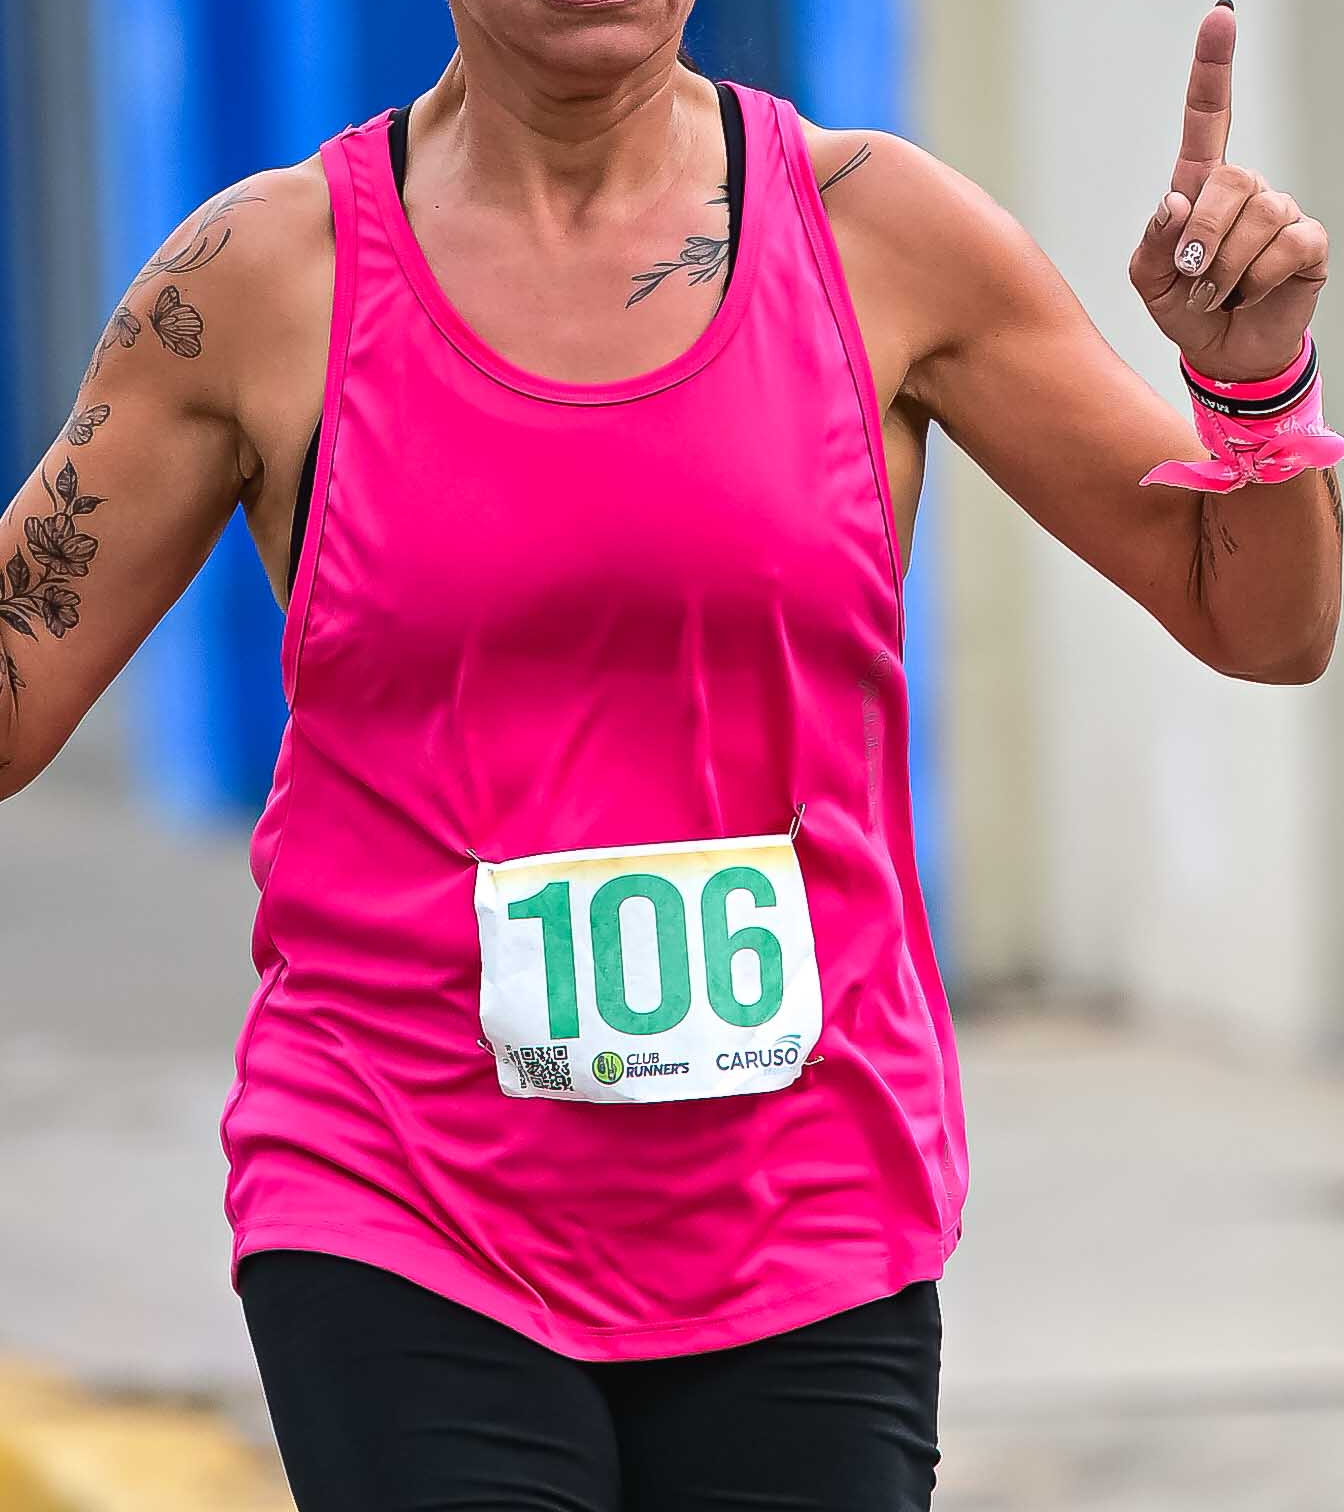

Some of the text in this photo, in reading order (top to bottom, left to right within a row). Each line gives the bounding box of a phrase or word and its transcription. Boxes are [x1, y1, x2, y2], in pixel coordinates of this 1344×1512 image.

[508, 866, 784, 1040] 106
[626, 1052, 660, 1066] CLUB
[716, 1047, 798, 1071] CARUSO
[625, 1061, 691, 1079] RUNNER'S
